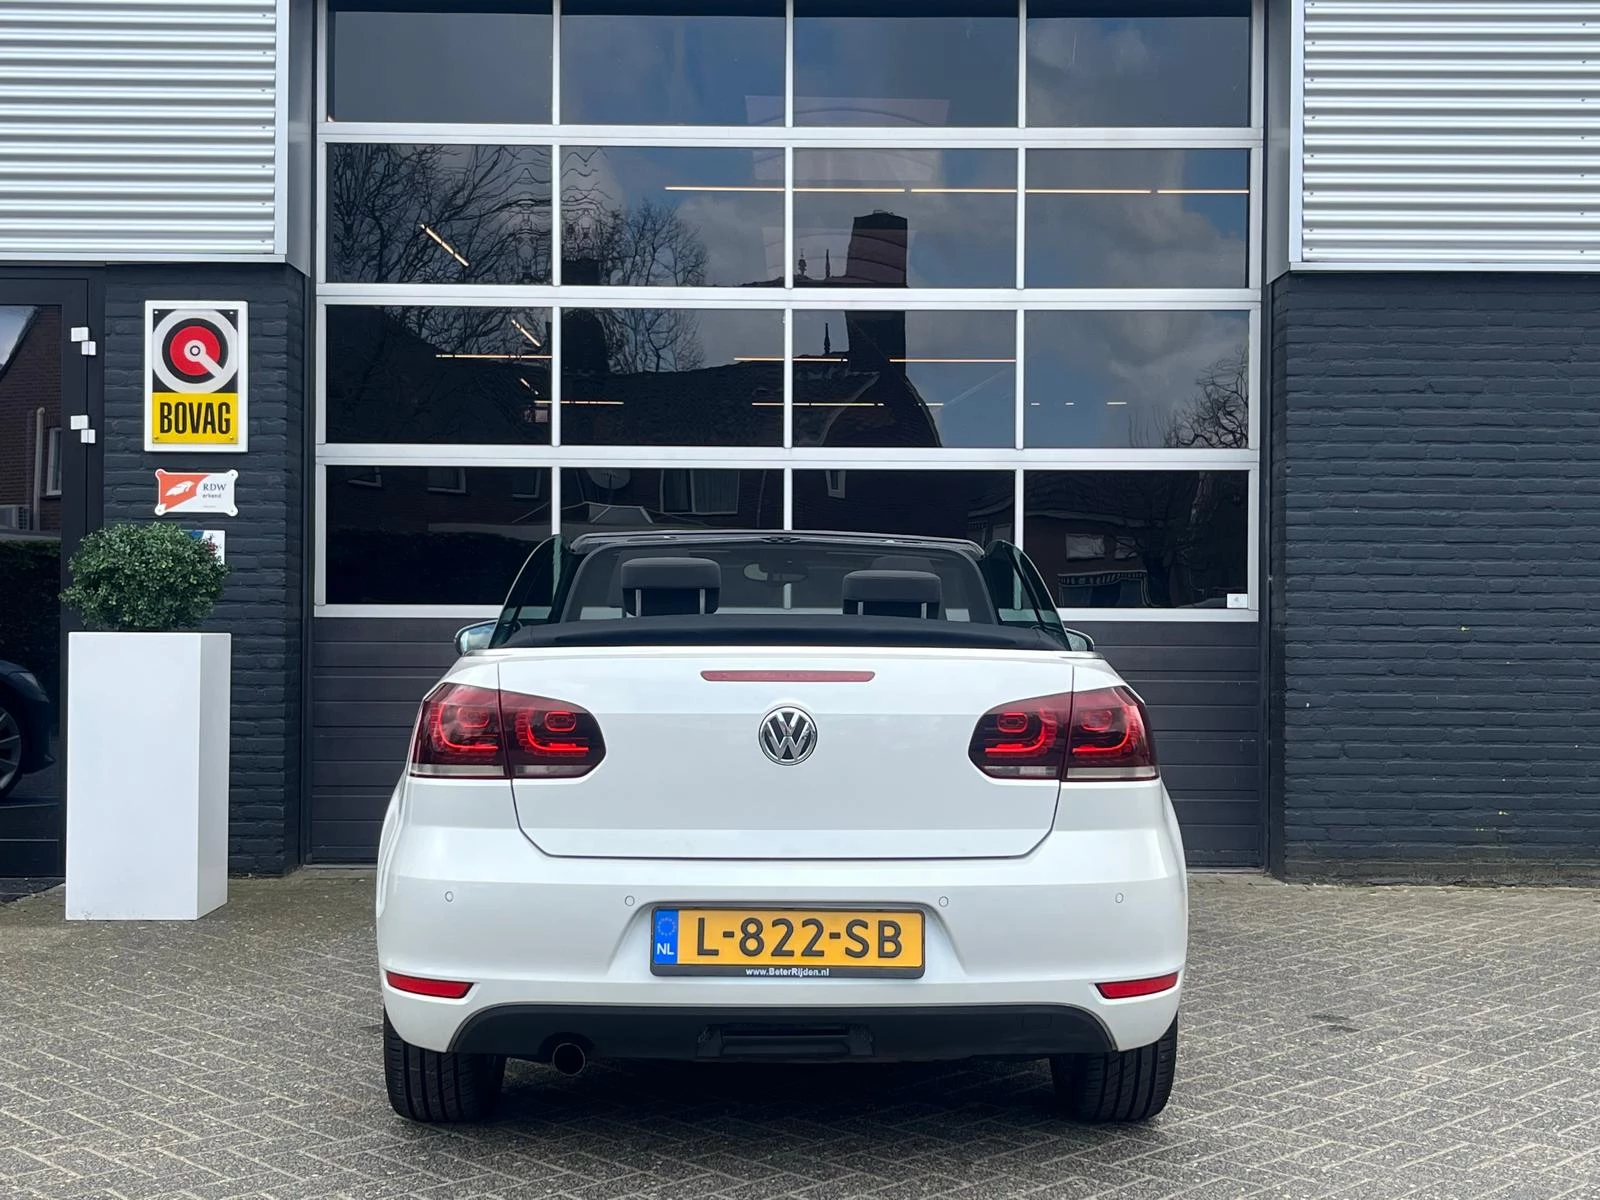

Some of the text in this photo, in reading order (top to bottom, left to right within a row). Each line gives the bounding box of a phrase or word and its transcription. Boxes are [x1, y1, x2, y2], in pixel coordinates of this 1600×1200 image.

[160, 402, 231, 435] BOVAG
[203, 483, 226, 491] RDW
[763, 708, 813, 763] VW
[656, 943, 674, 955] NL
[697, 917, 902, 959] L-822-SB
[745, 967, 829, 977] www.BeterRijden.nl
